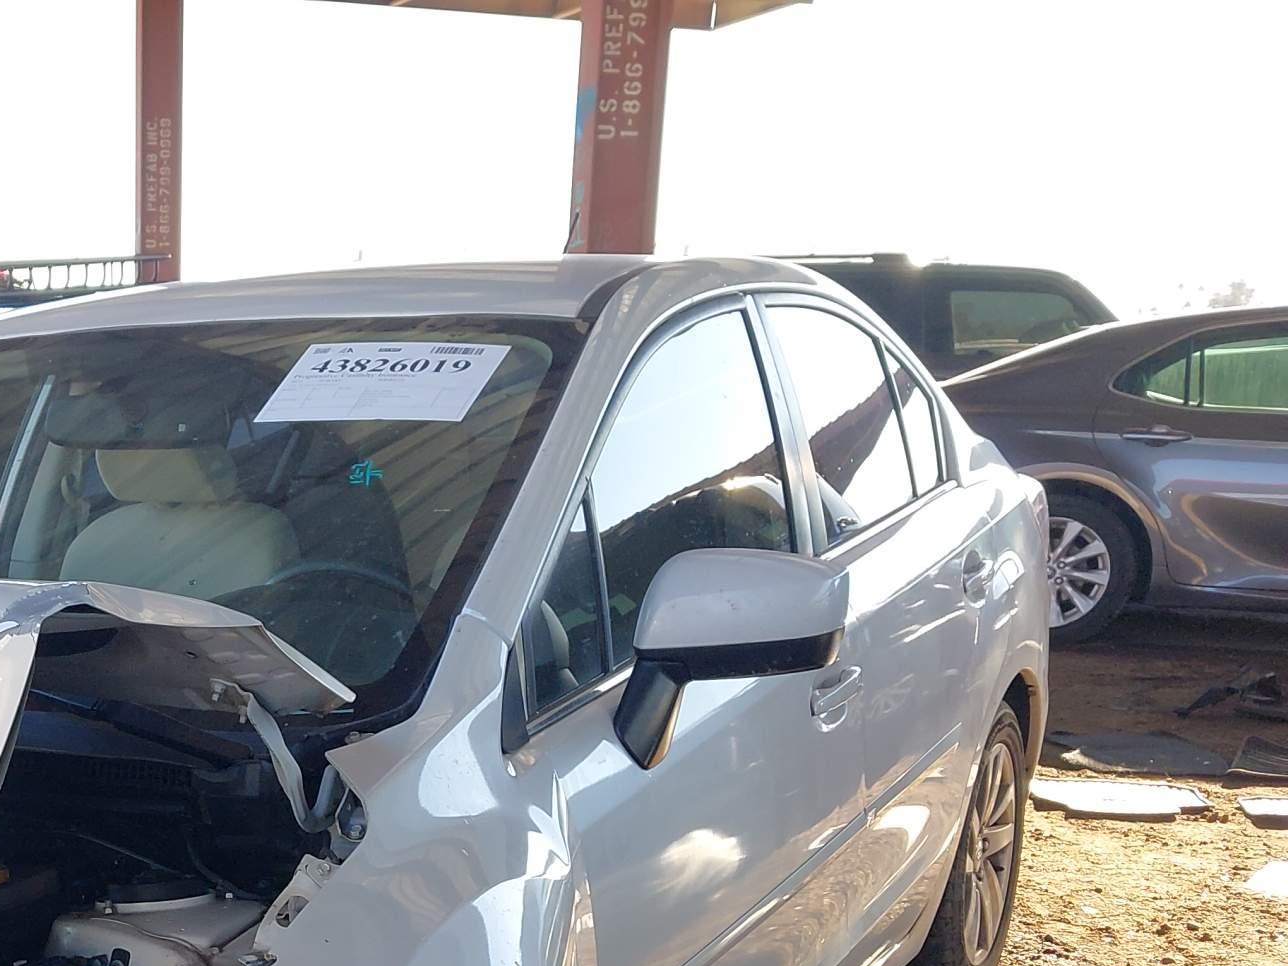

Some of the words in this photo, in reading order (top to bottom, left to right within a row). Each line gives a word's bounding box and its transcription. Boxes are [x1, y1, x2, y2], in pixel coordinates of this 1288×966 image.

[602, 0, 626, 74] PREF
[597, 89, 618, 140] U.S.
[311, 358, 472, 374] 43826019
